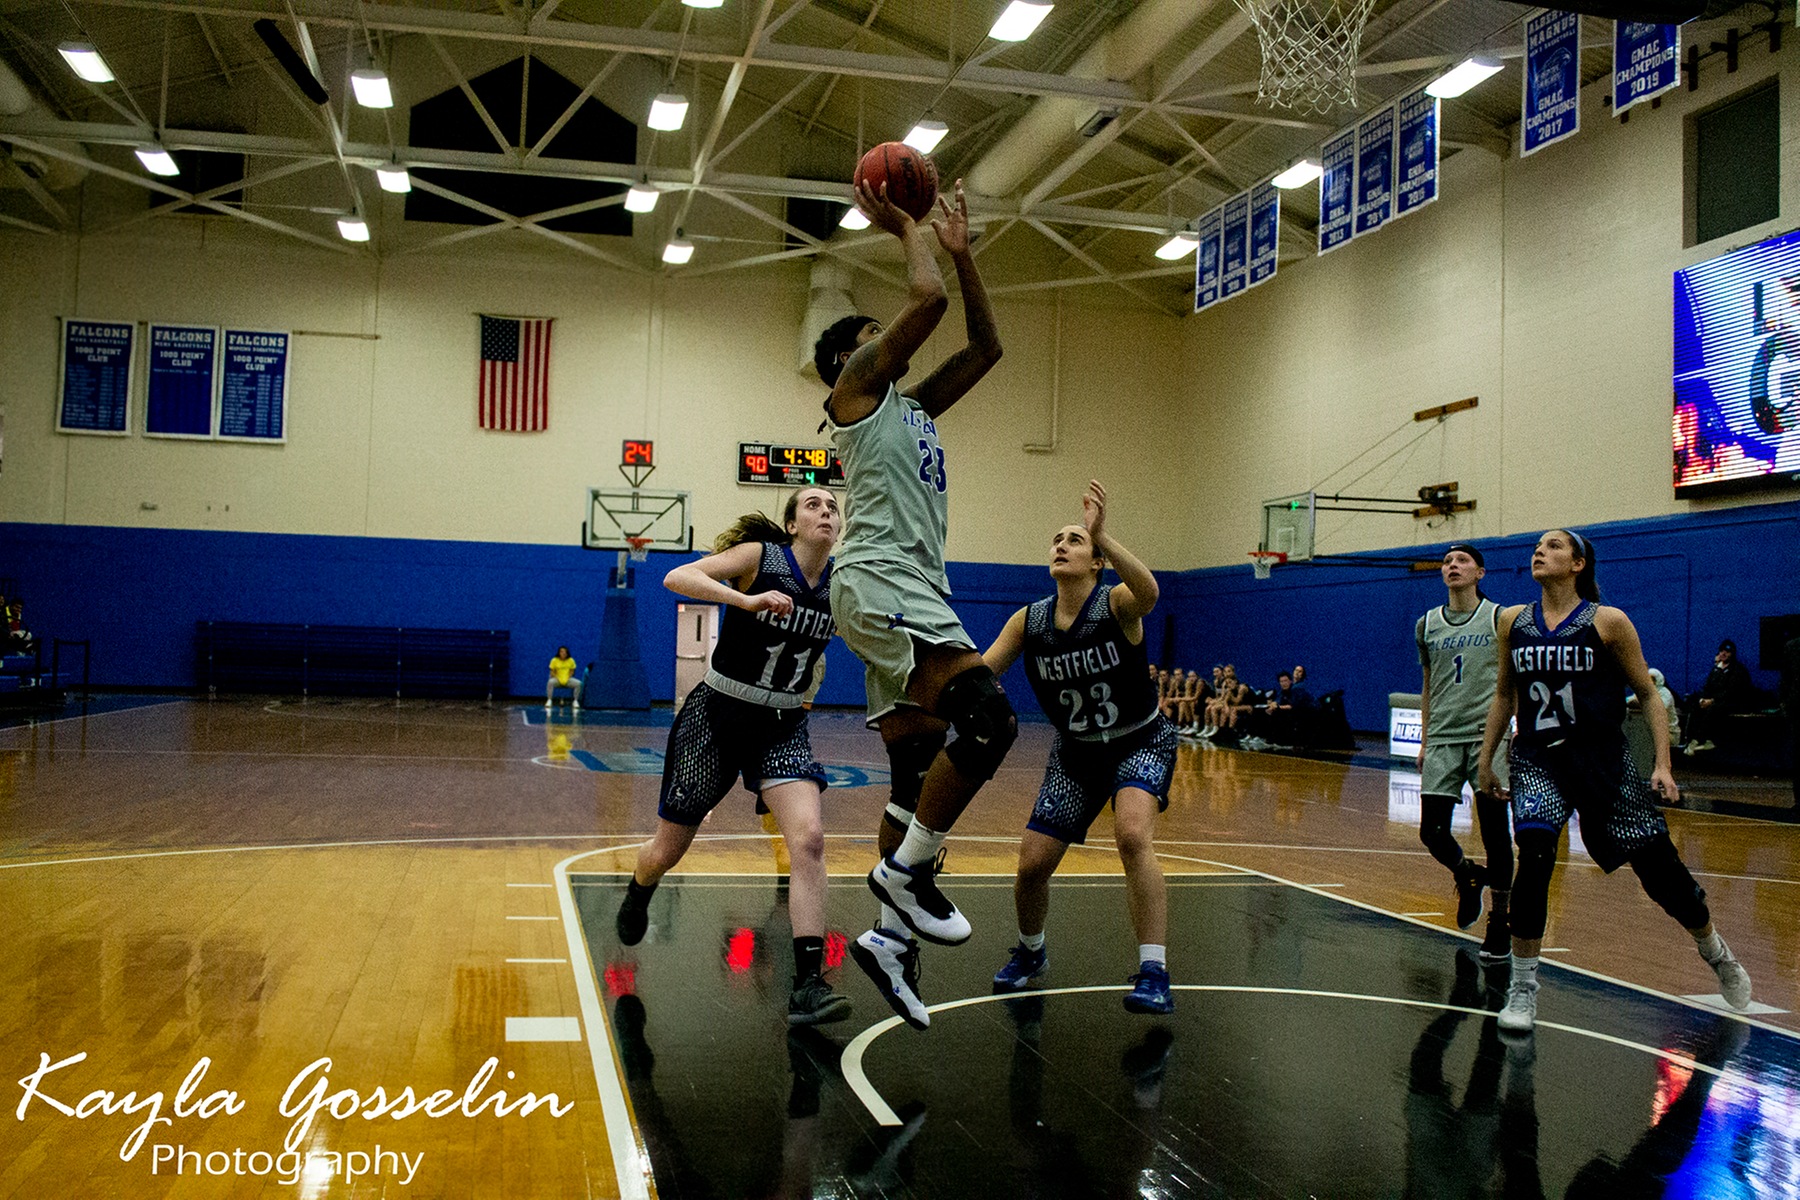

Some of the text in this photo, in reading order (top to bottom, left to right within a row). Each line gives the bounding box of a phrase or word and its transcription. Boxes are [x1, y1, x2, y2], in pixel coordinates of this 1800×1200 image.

[1529, 13, 1576, 49] MAGNUS
[1616, 46, 1674, 86] CHAMPIONS
[1630, 71, 1660, 97] 2019
[1526, 97, 1575, 130] CHAMPIONS
[1538, 118, 1563, 141] 2017
[1400, 169, 1435, 194] CHAMPIONS
[1357, 191, 1391, 216] CHAMPIONS
[70, 325, 129, 339] FALCONS
[154, 330, 212, 343] FALCONS
[229, 334, 285, 347] FALCONS
[75, 346, 122, 356] 1000 POINT
[87, 355, 109, 363] CLUB
[160, 350, 206, 360] 1000 POINT
[233, 355, 279, 364] 1000 POINT
[171, 359, 193, 367] CLUB
[245, 363, 266, 371] CLUB
[624, 441, 652, 464] 24
[743, 445, 767, 455] HOME
[783, 448, 827, 467] 4:48
[745, 455, 768, 474] 90
[917, 437, 948, 494] 23
[750, 474, 770, 482] BONUS
[805, 471, 815, 485] 4
[1428, 633, 1491, 652] ALBERTUS
[755, 641, 812, 693] 11
[1035, 640, 1120, 681] WESTFIELD
[1452, 653, 1463, 685] 1
[1059, 682, 1120, 732] 23
[1529, 680, 1577, 731] 21
